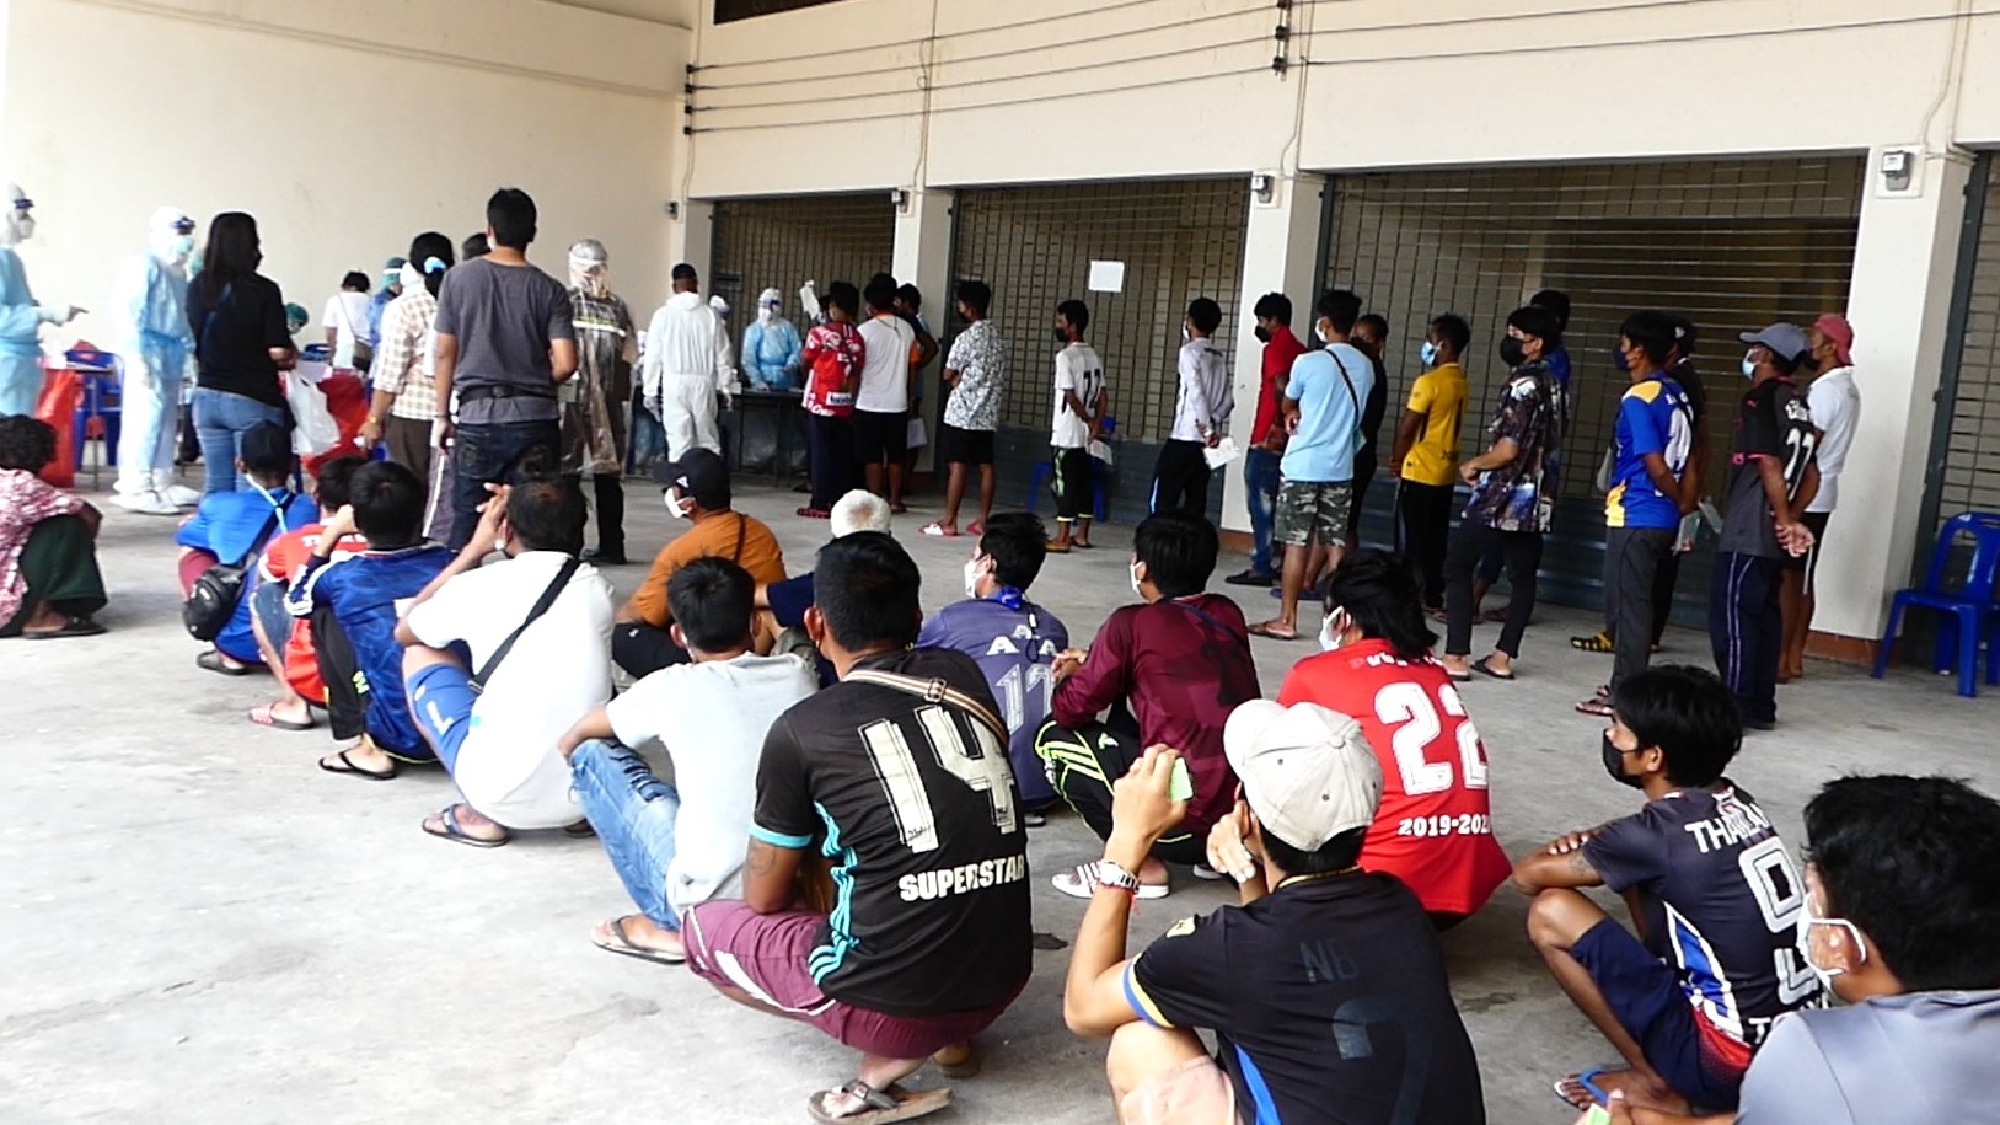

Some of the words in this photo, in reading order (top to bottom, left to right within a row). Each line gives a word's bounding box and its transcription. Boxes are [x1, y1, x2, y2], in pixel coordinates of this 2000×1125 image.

[858, 704, 1016, 853] 14
[1374, 681, 1490, 795] 22
[899, 855, 1025, 901] SUPERSTAR
